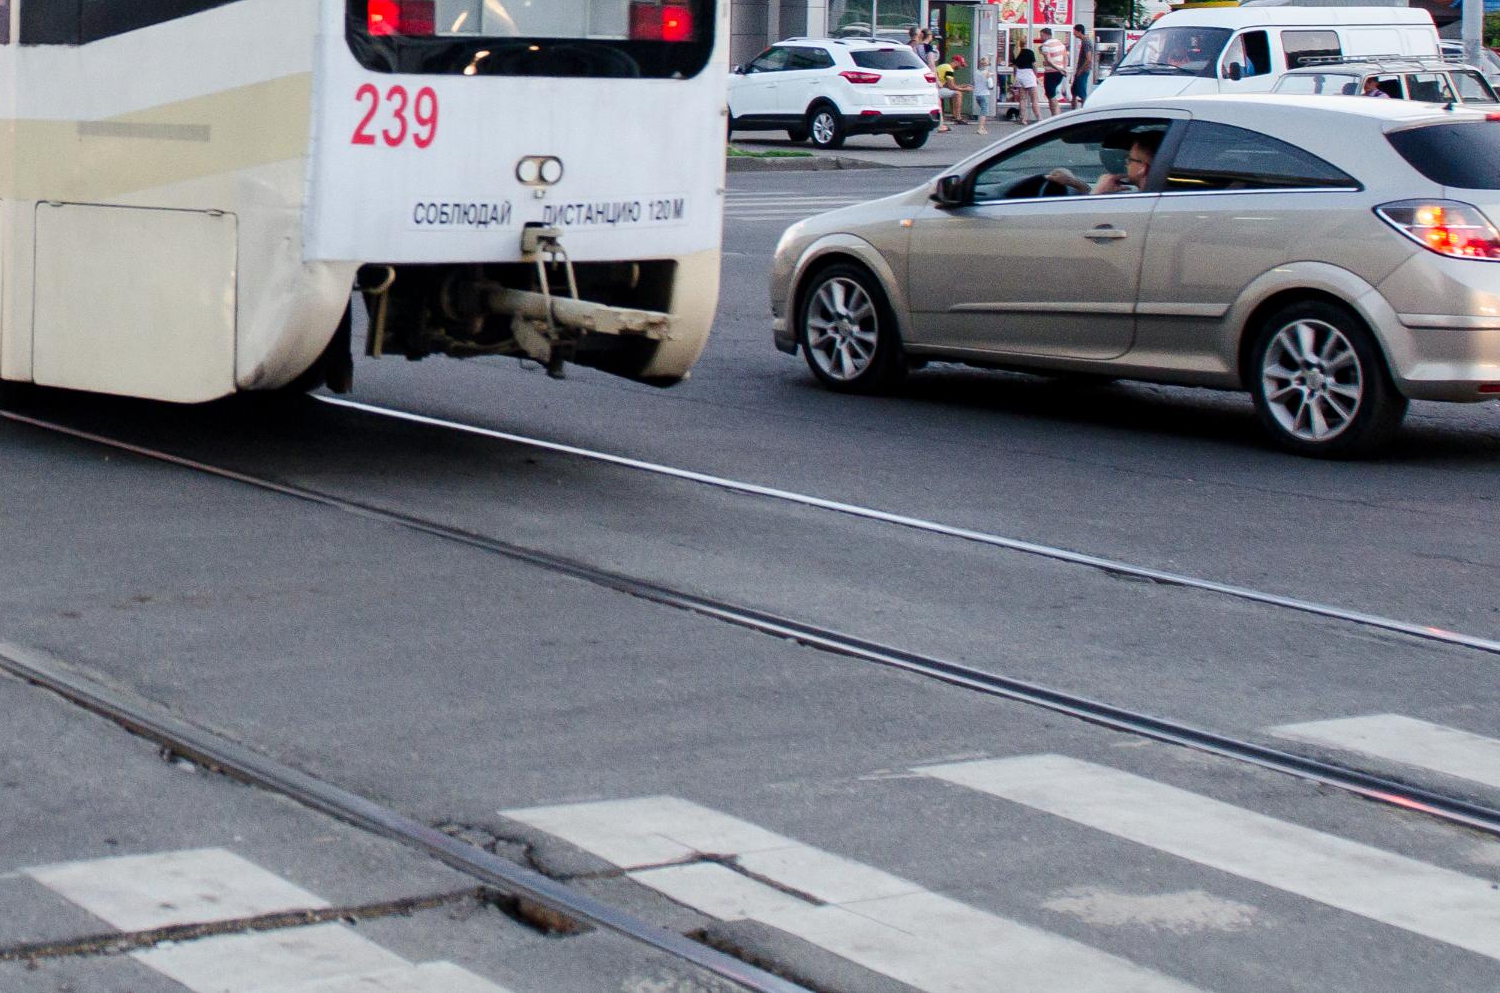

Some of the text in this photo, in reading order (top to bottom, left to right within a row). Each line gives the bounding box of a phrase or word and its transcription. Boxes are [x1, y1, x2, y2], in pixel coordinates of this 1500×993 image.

[351, 83, 438, 148] 239
[413, 201, 512, 227] СОБЛЮДАЙ
[542, 201, 641, 227] ДИСТАНЦИЮ
[648, 200, 671, 221] 120
